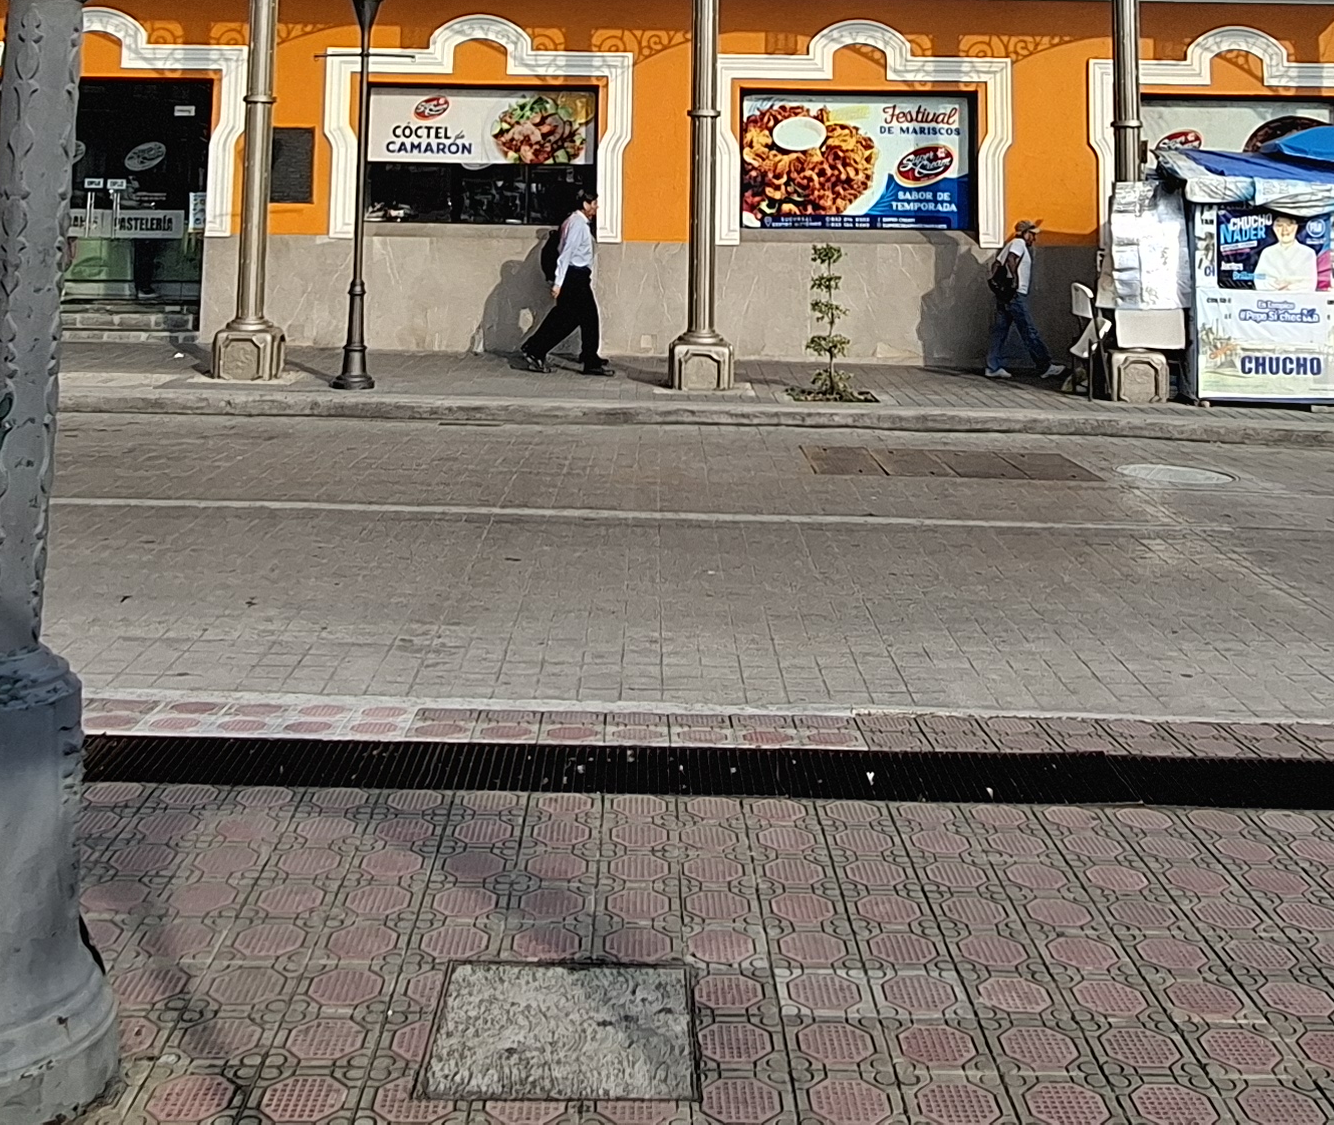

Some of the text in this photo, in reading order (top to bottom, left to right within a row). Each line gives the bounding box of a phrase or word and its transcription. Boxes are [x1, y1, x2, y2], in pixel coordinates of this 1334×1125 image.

[882, 104, 958, 126] Festival
[392, 122, 451, 140] CÓCTEL
[879, 126, 961, 136] DE MARISCOS
[897, 191, 951, 201] SABOR DE
[891, 201, 958, 212] TEMPORADA
[1229, 213, 1273, 232] CHUCHO
[1220, 224, 1267, 244] NADER
[1240, 355, 1323, 376] CHUCHO
